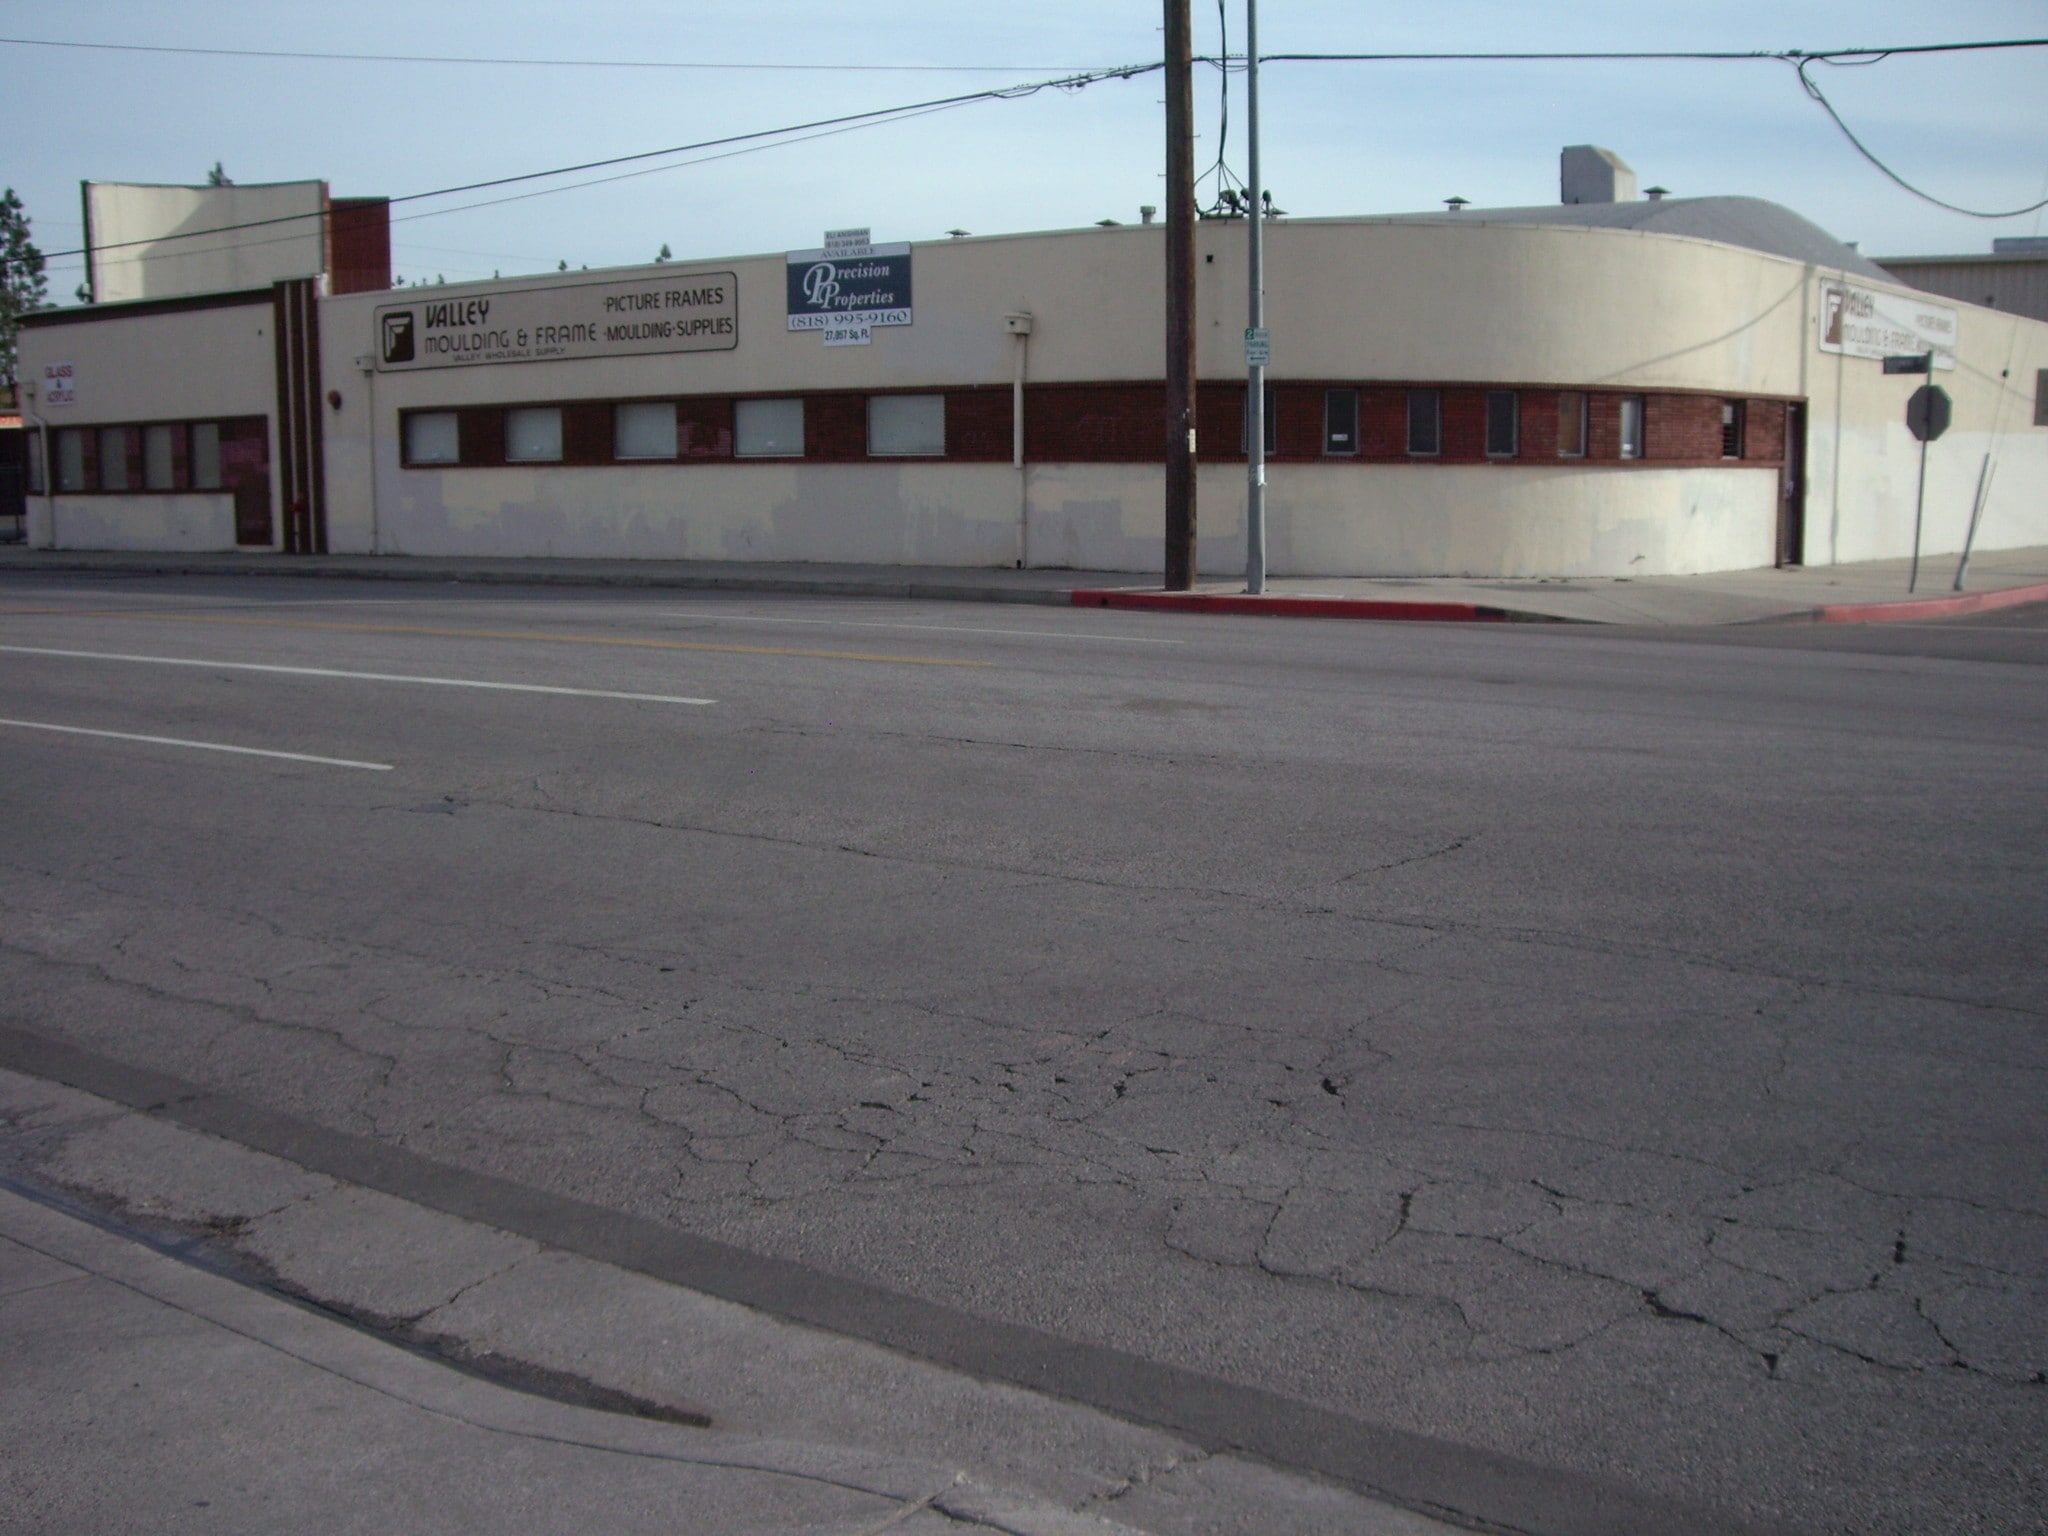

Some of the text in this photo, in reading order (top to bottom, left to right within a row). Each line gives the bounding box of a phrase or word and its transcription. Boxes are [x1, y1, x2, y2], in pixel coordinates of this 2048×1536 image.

[820, 248, 874, 259] AVAILABLE
[803, 262, 890, 304] Precision
[819, 281, 894, 310] Properties
[606, 287, 724, 312] PICTURE FRAMES
[425, 300, 490, 329] VALLEY
[791, 311, 907, 328] (818) 995-9160
[425, 322, 597, 354] MOULDING & FRAME
[607, 317, 734, 341] MOULDING SUPPLIES
[453, 352, 482, 363] VALLEY
[485, 349, 531, 361] WHOLESALE
